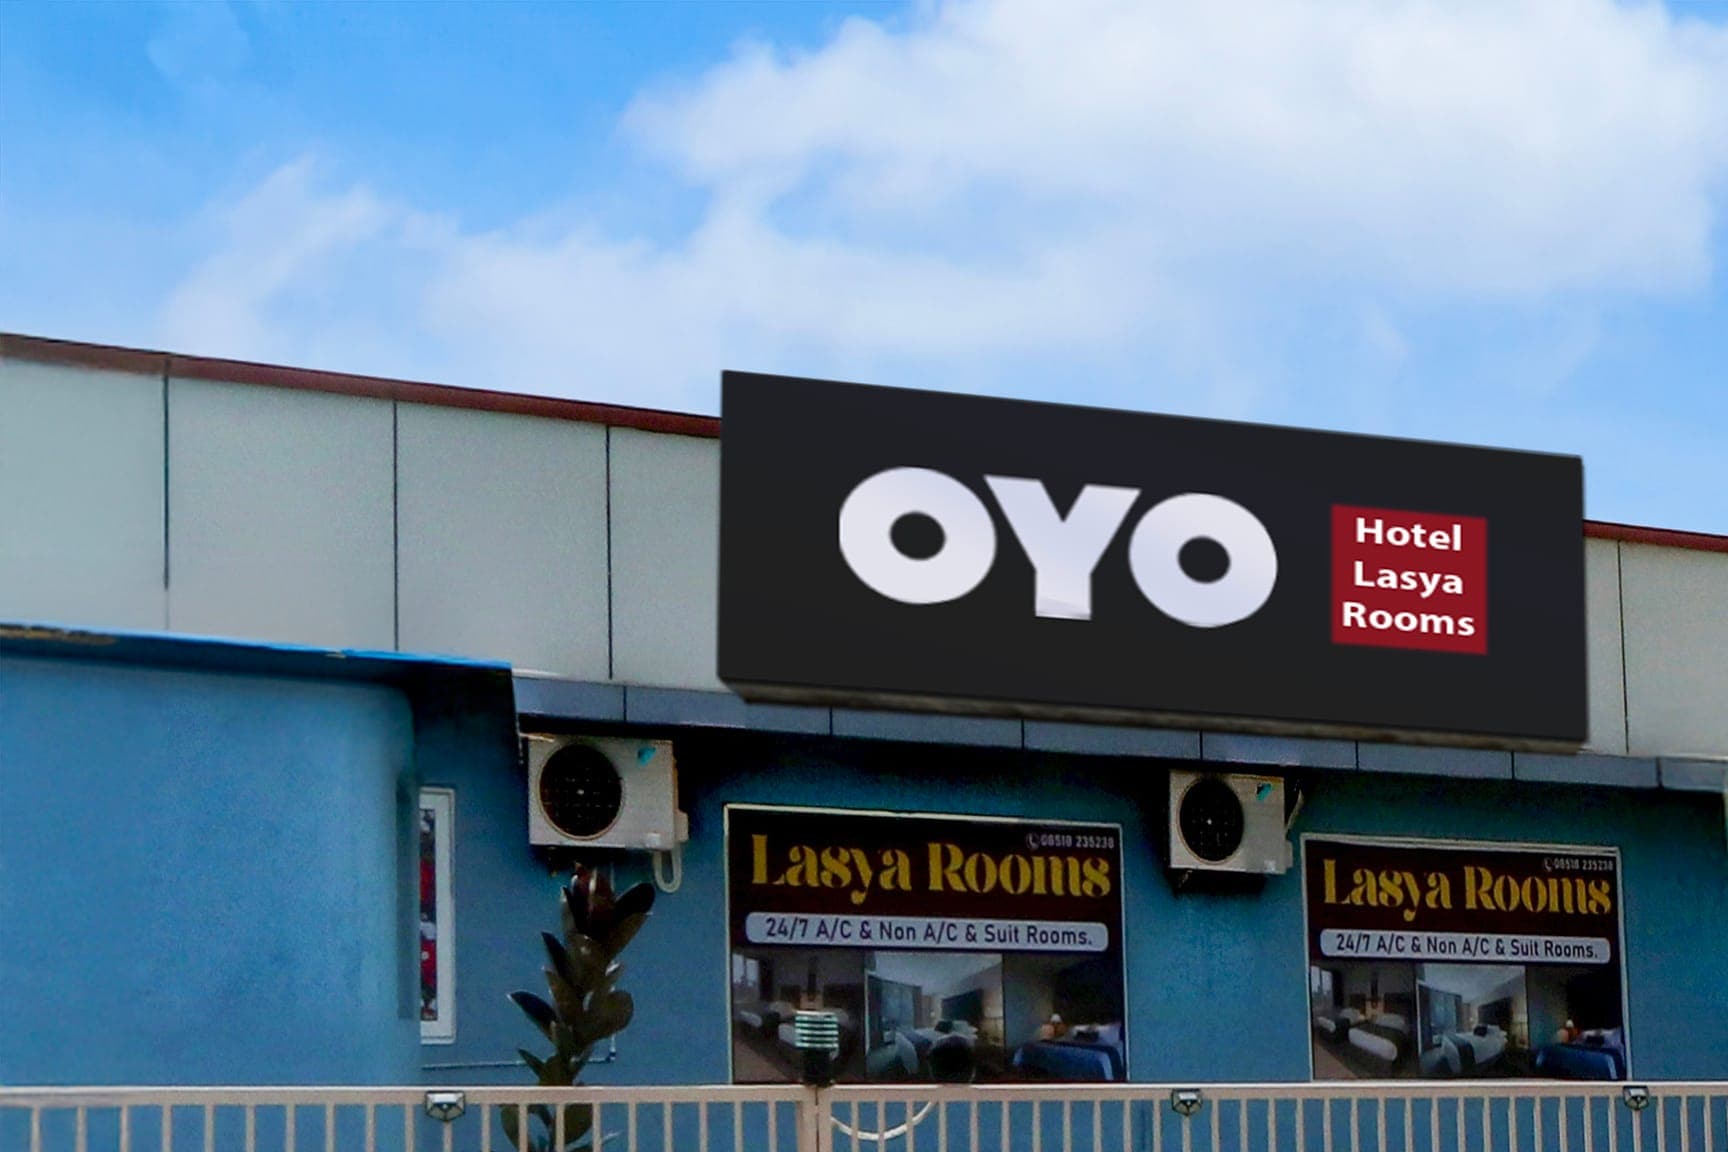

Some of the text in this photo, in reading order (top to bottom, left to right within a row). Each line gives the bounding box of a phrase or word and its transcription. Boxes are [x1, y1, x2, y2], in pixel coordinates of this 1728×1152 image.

[838, 466, 1277, 628] OYO
[1355, 517, 1462, 552] Hotel
[1353, 561, 1463, 596] Lasya
[1342, 601, 1476, 637] Rooms
[751, 833, 1112, 905] Lasya Rooms
[1323, 859, 1612, 922] Lasya Rooms
[765, 917, 1093, 946] 24/7 A/C & Non A/C & Suit Rooms.
[1336, 934, 1598, 958] 24/7 A/C & Non A/C & Suit Rooms.
